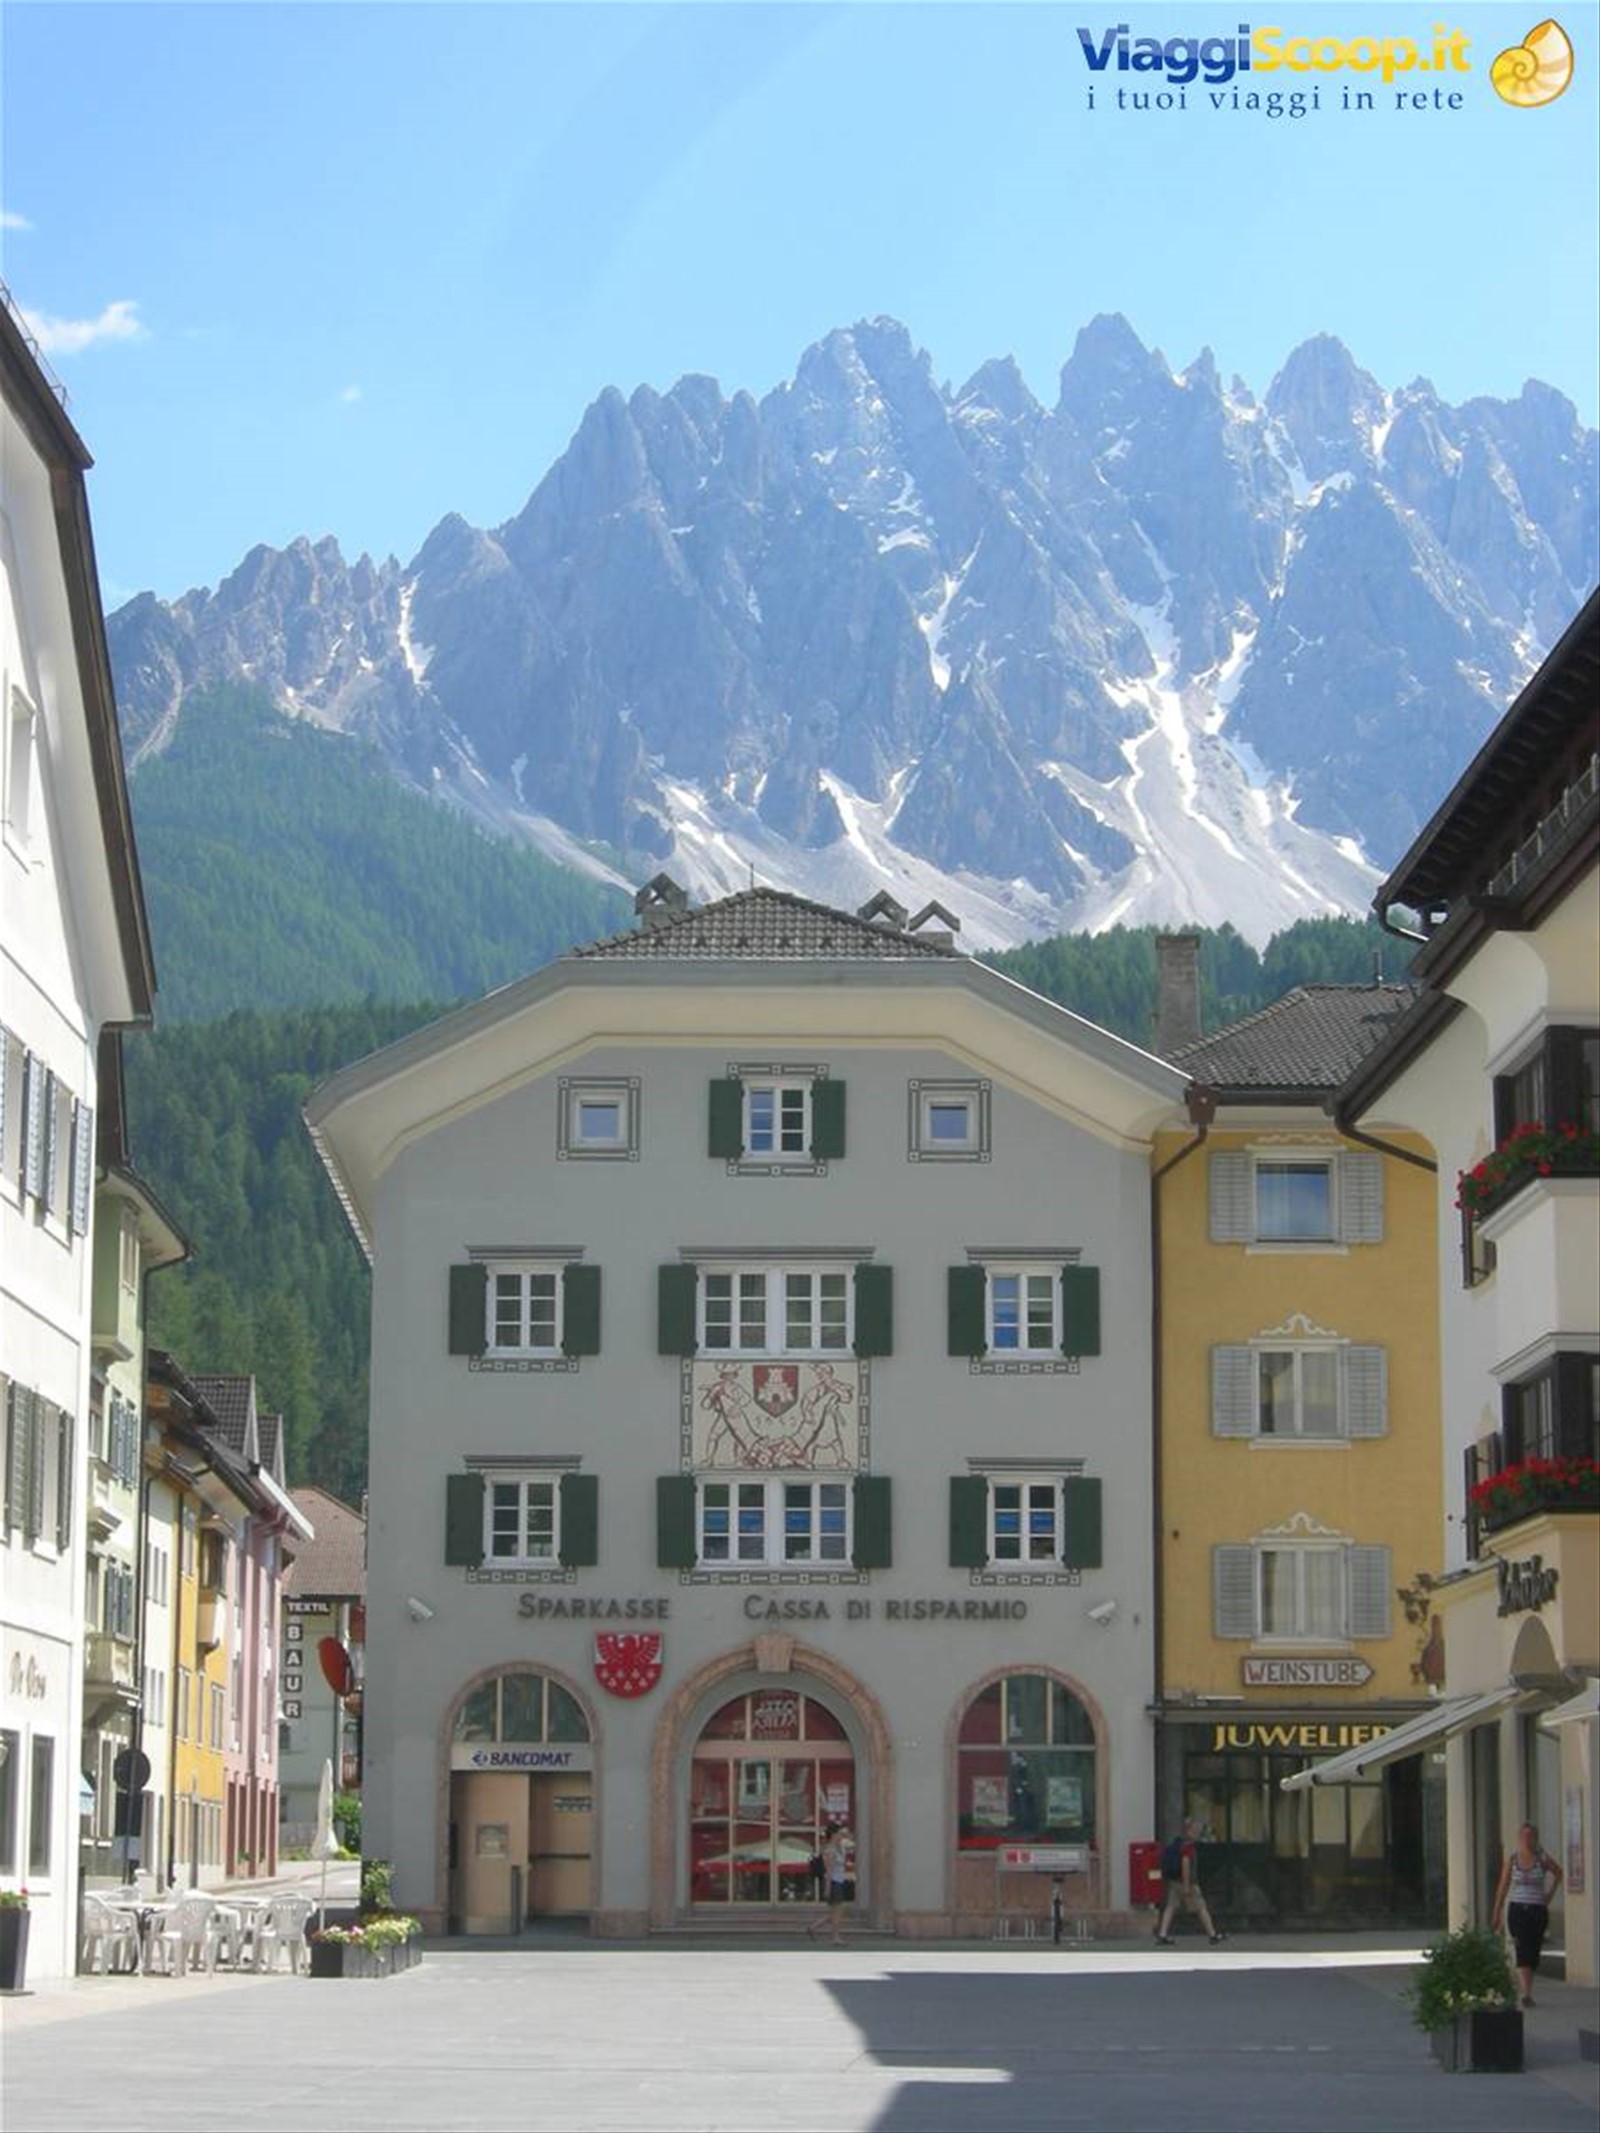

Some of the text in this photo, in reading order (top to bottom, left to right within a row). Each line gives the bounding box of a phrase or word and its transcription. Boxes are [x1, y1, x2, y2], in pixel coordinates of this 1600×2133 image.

[518, 1593, 670, 1620] SPARKASSE
[743, 1595, 1028, 1620] CASSA DI RISPARMIO
[286, 1625, 301, 1717] BAUR
[1247, 1662, 1362, 1682] WEINSTUBE
[490, 1752, 572, 1766] BANCOMAT
